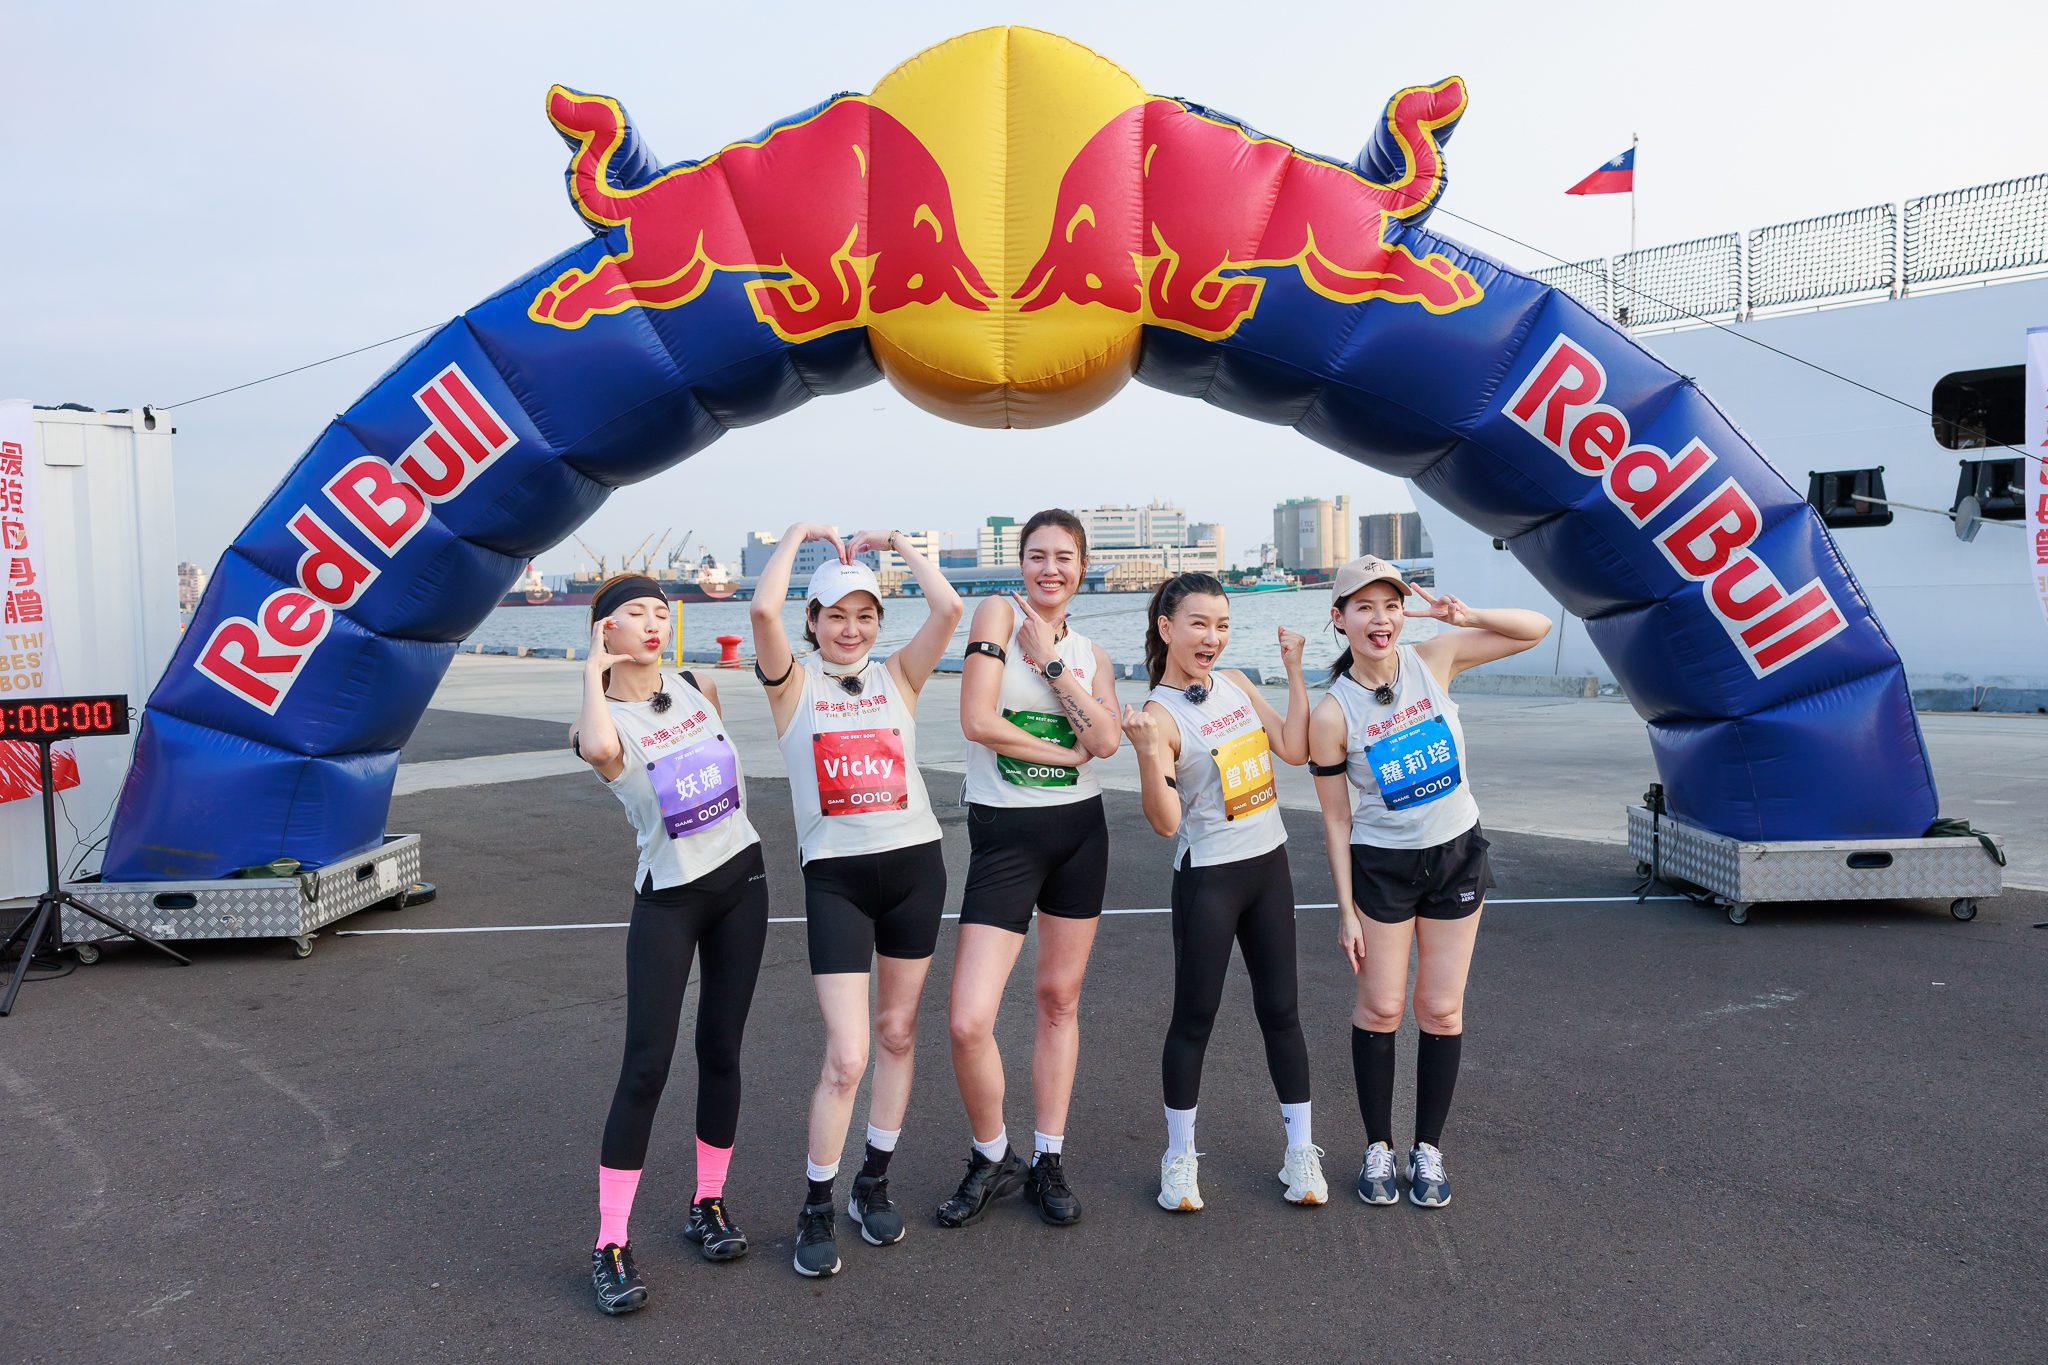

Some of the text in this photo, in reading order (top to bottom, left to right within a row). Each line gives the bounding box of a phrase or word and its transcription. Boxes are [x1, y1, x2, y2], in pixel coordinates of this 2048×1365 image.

[1501, 333, 1849, 680] Red Bull
[194, 362, 519, 716] Red Bull
[1392, 723, 1407, 733] BEST
[1409, 714, 1426, 725] BODY
[823, 754, 894, 780] Vicky
[1027, 767, 1066, 778] 0010
[1378, 739, 1451, 786] 蘿莉塔
[675, 763, 722, 801] 妖嬌
[1250, 786, 1273, 805] 0010
[1393, 775, 1452, 804] GAME 0010
[674, 797, 729, 828] GAME 0010
[851, 791, 892, 805] 0010
